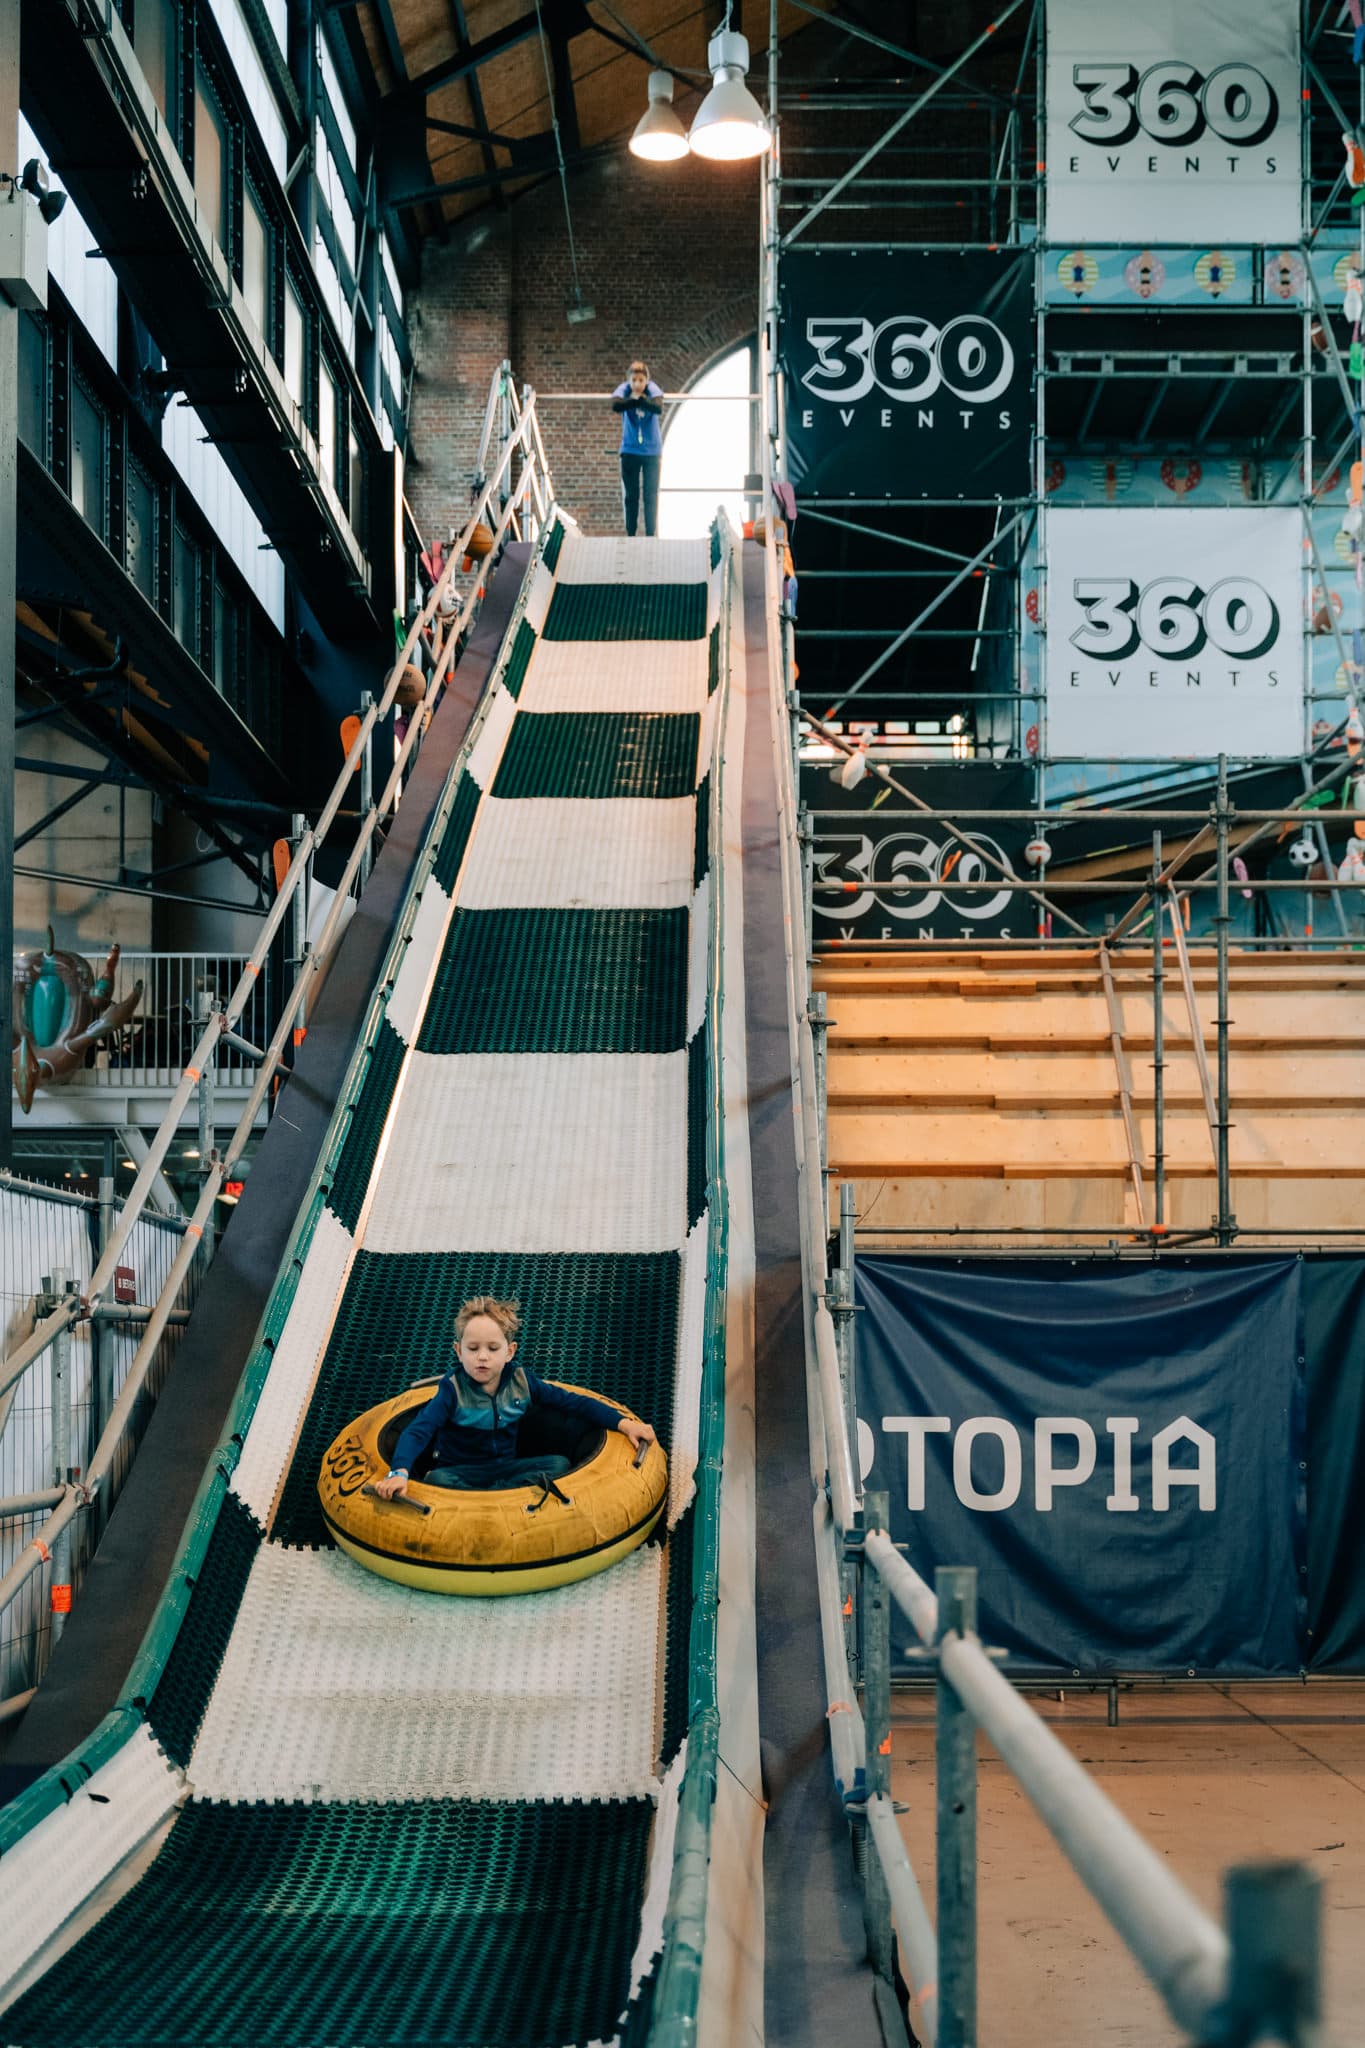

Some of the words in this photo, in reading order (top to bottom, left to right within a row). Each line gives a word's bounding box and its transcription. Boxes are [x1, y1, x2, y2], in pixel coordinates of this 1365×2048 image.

[1068, 60, 1279, 147] 360
[1070, 156, 1277, 174] EVENTS
[801, 314, 1014, 403] 360
[802, 409, 1011, 429] EVENTS
[1069, 576, 1279, 661] 360
[1071, 671, 1278, 687] EVENTS
[812, 831, 1014, 920] 360
[839, 927, 1012, 941] VENTS
